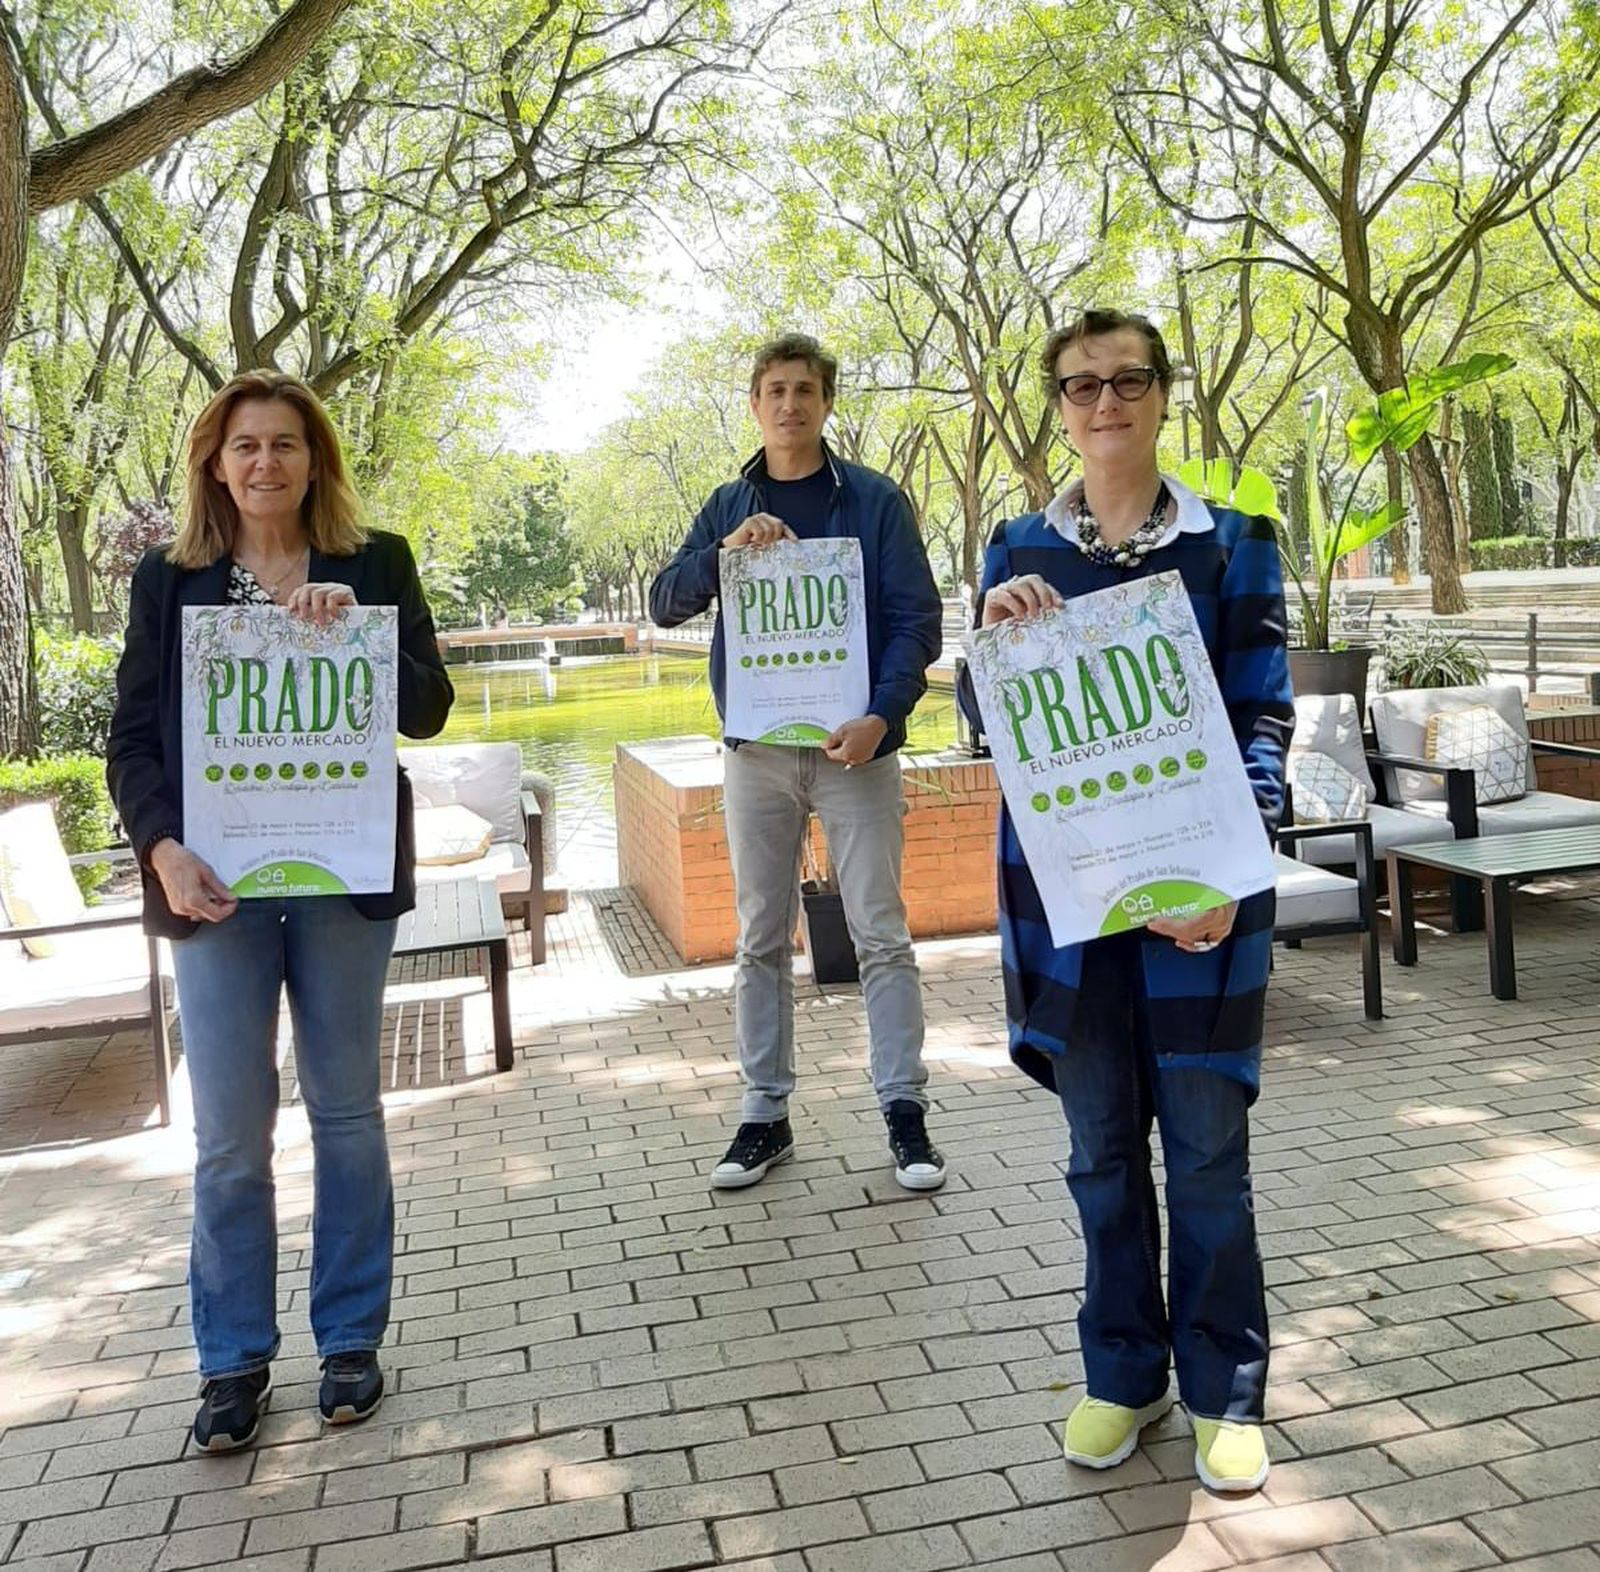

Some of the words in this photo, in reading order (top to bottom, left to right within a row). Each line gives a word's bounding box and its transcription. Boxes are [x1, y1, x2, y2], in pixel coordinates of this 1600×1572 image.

[738, 574, 848, 635] PRADO
[746, 635, 755, 645] EL
[758, 632, 792, 643] NUEVO
[795, 628, 845, 640] MERCADO
[204, 656, 374, 735] PRADO
[1000, 634, 1190, 763] PRADO
[214, 736, 228, 749] EL
[234, 735, 287, 748] NUEVO
[292, 733, 367, 747] MERCADO
[1030, 762, 1047, 775] EL
[1049, 743, 1105, 768] NUEVO
[1111, 719, 1193, 752] MERCADO
